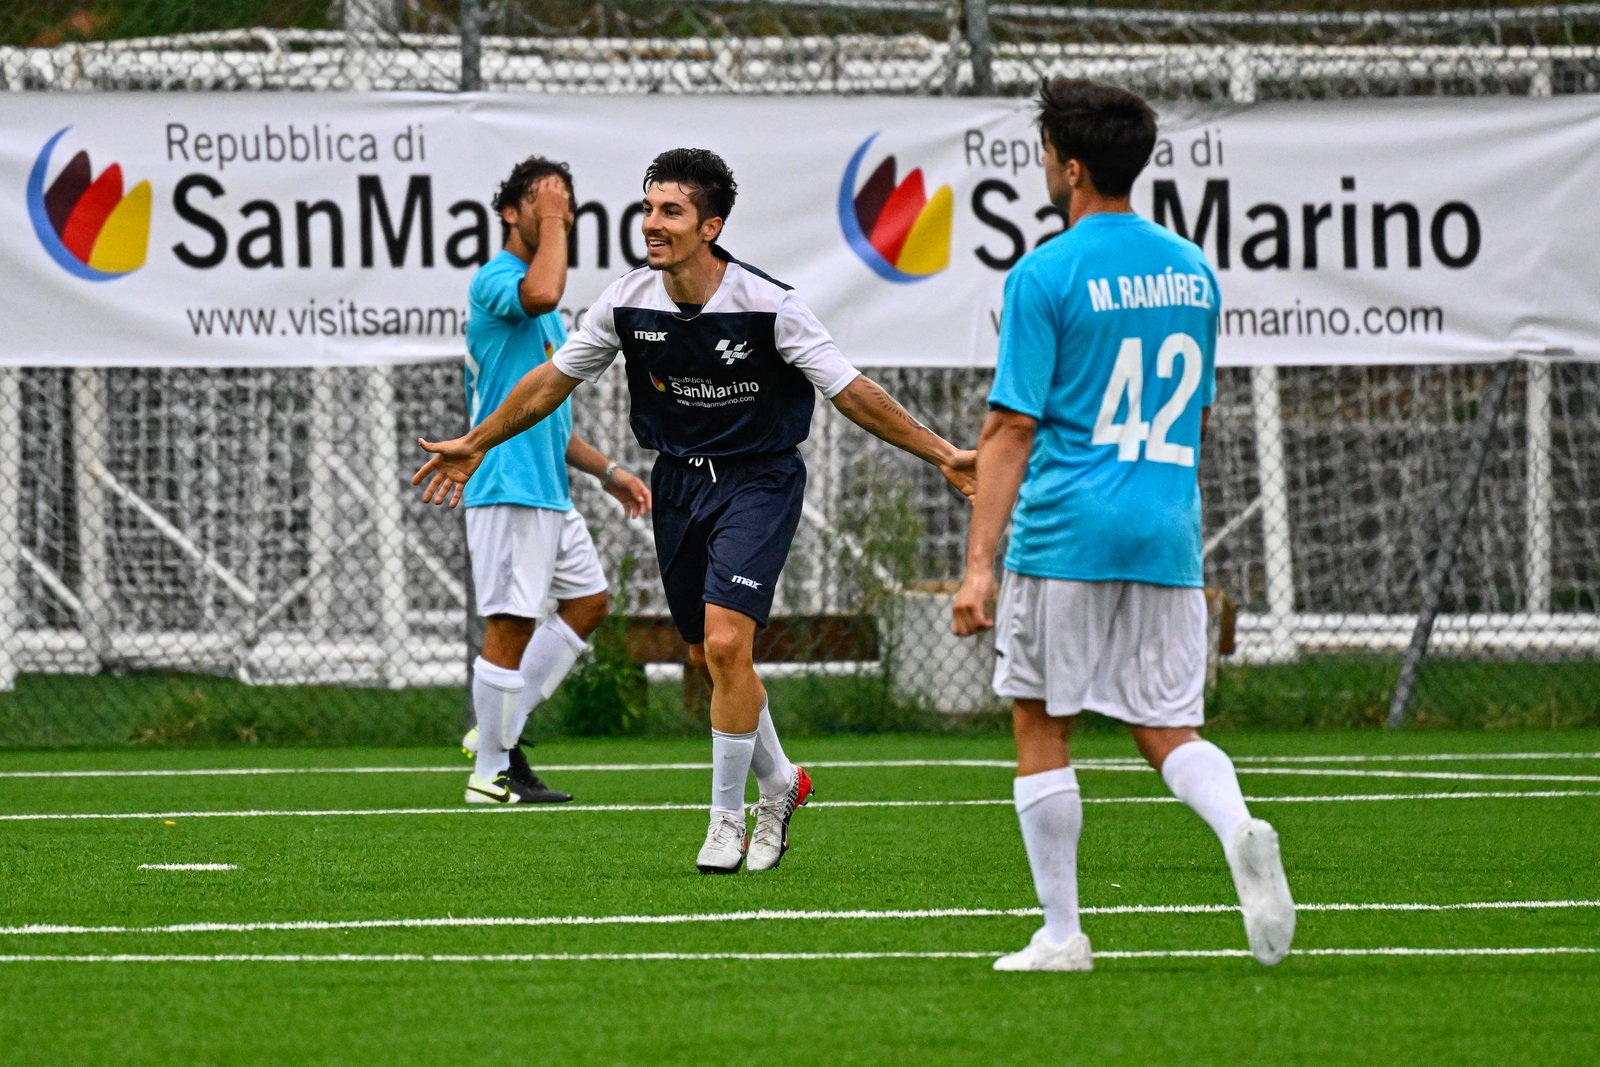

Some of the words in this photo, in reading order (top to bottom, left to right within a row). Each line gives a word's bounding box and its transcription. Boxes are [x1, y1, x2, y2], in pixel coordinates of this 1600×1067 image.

[166, 122, 378, 171] Repubblica
[393, 123, 425, 162] di
[1190, 126, 1223, 167] di
[172, 173, 648, 270] SanMano
[633, 330, 669, 342] max
[671, 380, 760, 399] SanMarino
[1092, 332, 1203, 467] 42
[731, 575, 763, 590] max
